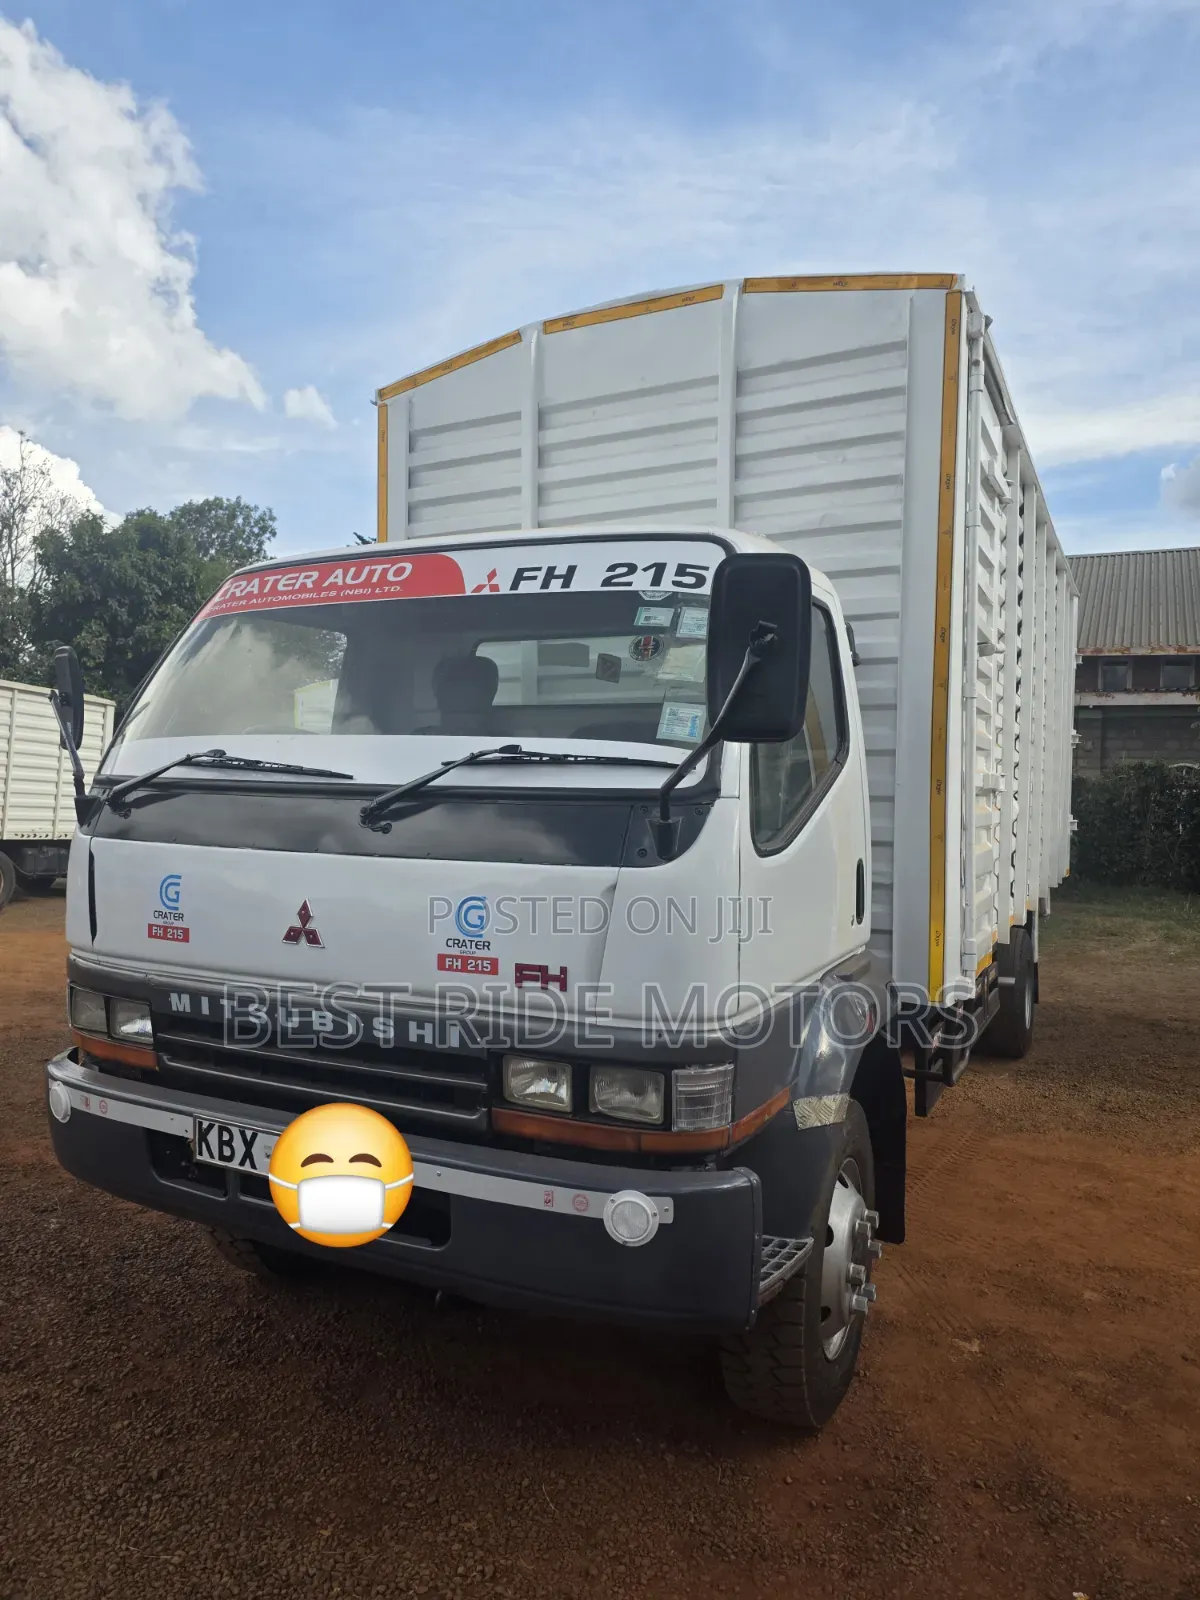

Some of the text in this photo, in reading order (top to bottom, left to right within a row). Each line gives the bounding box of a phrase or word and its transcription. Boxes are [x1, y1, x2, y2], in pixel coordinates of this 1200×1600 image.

[214, 562, 413, 602] CRATER AUTO
[509, 562, 710, 591] FH 215
[249, 590, 337, 605] AUTOMOBILES
[340, 588, 372, 597] (NBI)
[375, 585, 403, 594] LTD.
[153, 910, 184, 921] CRATER
[152, 926, 183, 940] FH 215
[446, 938, 491, 951] CRATER
[445, 957, 491, 972] FH 215
[514, 962, 568, 992] FH
[170, 992, 460, 1048] MITSUBISHI
[198, 1120, 258, 1170] KBX
